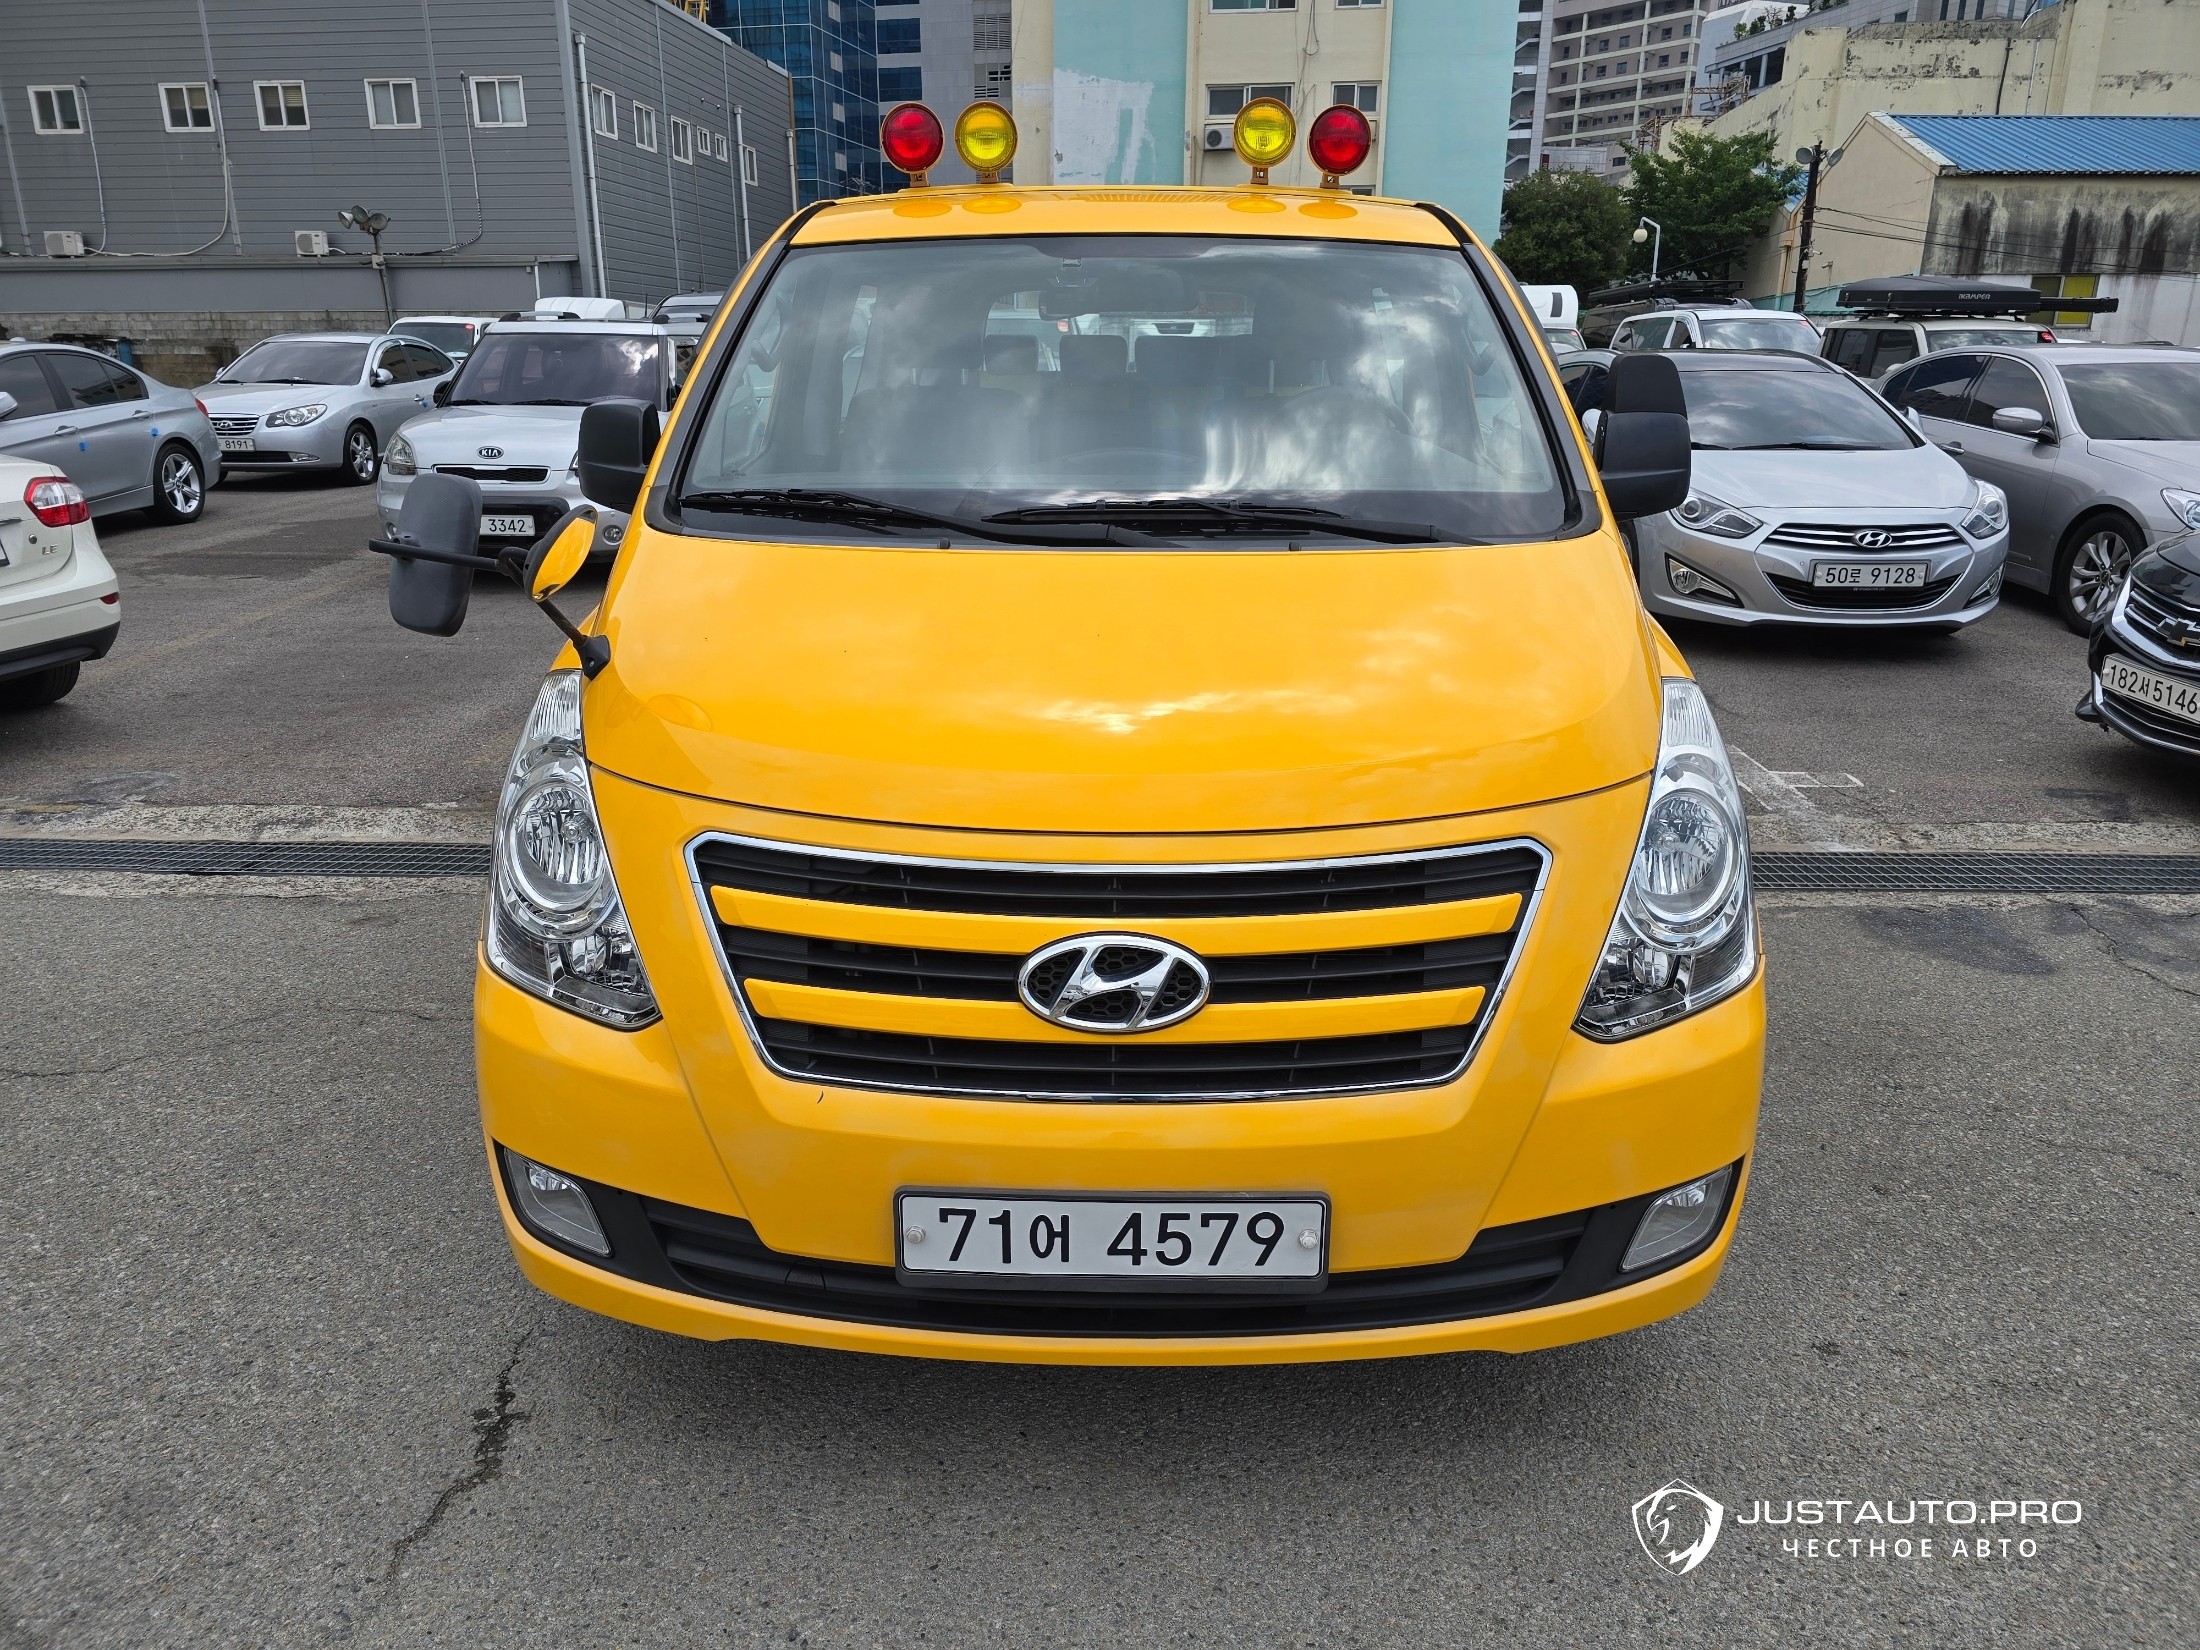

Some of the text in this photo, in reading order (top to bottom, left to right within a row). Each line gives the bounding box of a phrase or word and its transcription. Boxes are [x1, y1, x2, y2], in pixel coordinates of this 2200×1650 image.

[225, 440, 248, 450] 8191
[481, 448, 499, 456] KIA
[488, 519, 527, 533] 3342
[41, 544, 58, 555] LE
[1825, 567, 1916, 584] 50로 9128
[938, 1207, 1285, 1267] 71어 4579
